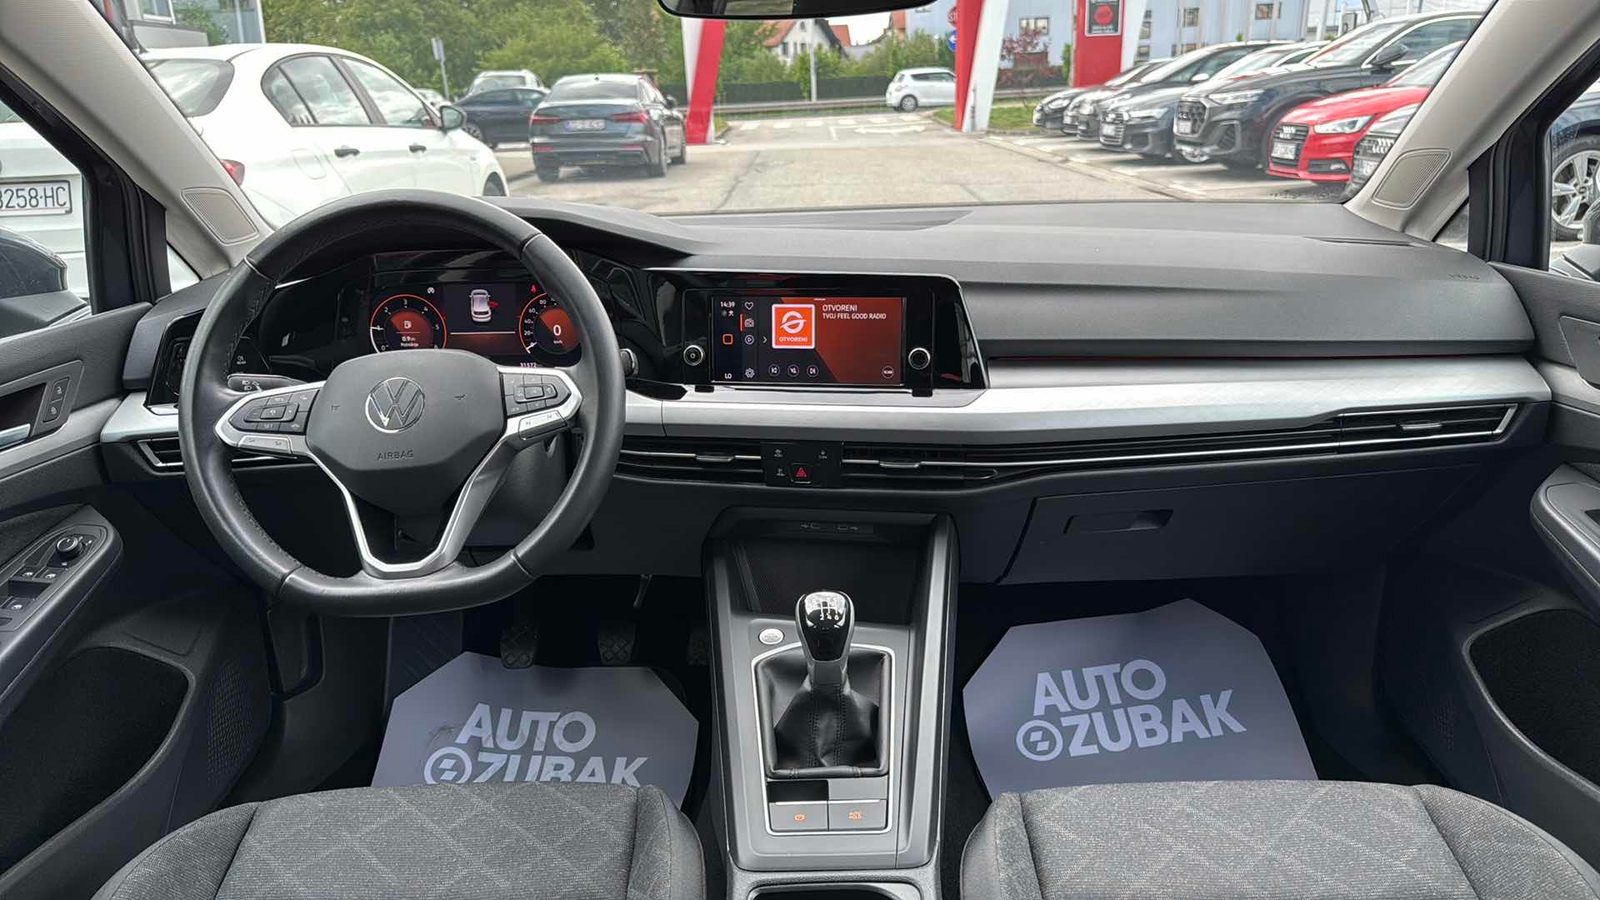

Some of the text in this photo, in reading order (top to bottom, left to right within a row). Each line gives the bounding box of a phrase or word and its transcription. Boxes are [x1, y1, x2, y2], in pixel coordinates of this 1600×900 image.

[822, 304, 858, 312] OTVORENI
[822, 312, 887, 320] TVOJ FEEL GOOD RADIO
[552, 324, 562, 336] 0
[377, 449, 414, 461] AIRBAG
[1032, 659, 1167, 717] AUTO
[455, 702, 597, 753] AUTO
[1060, 689, 1248, 757] ZUBAK
